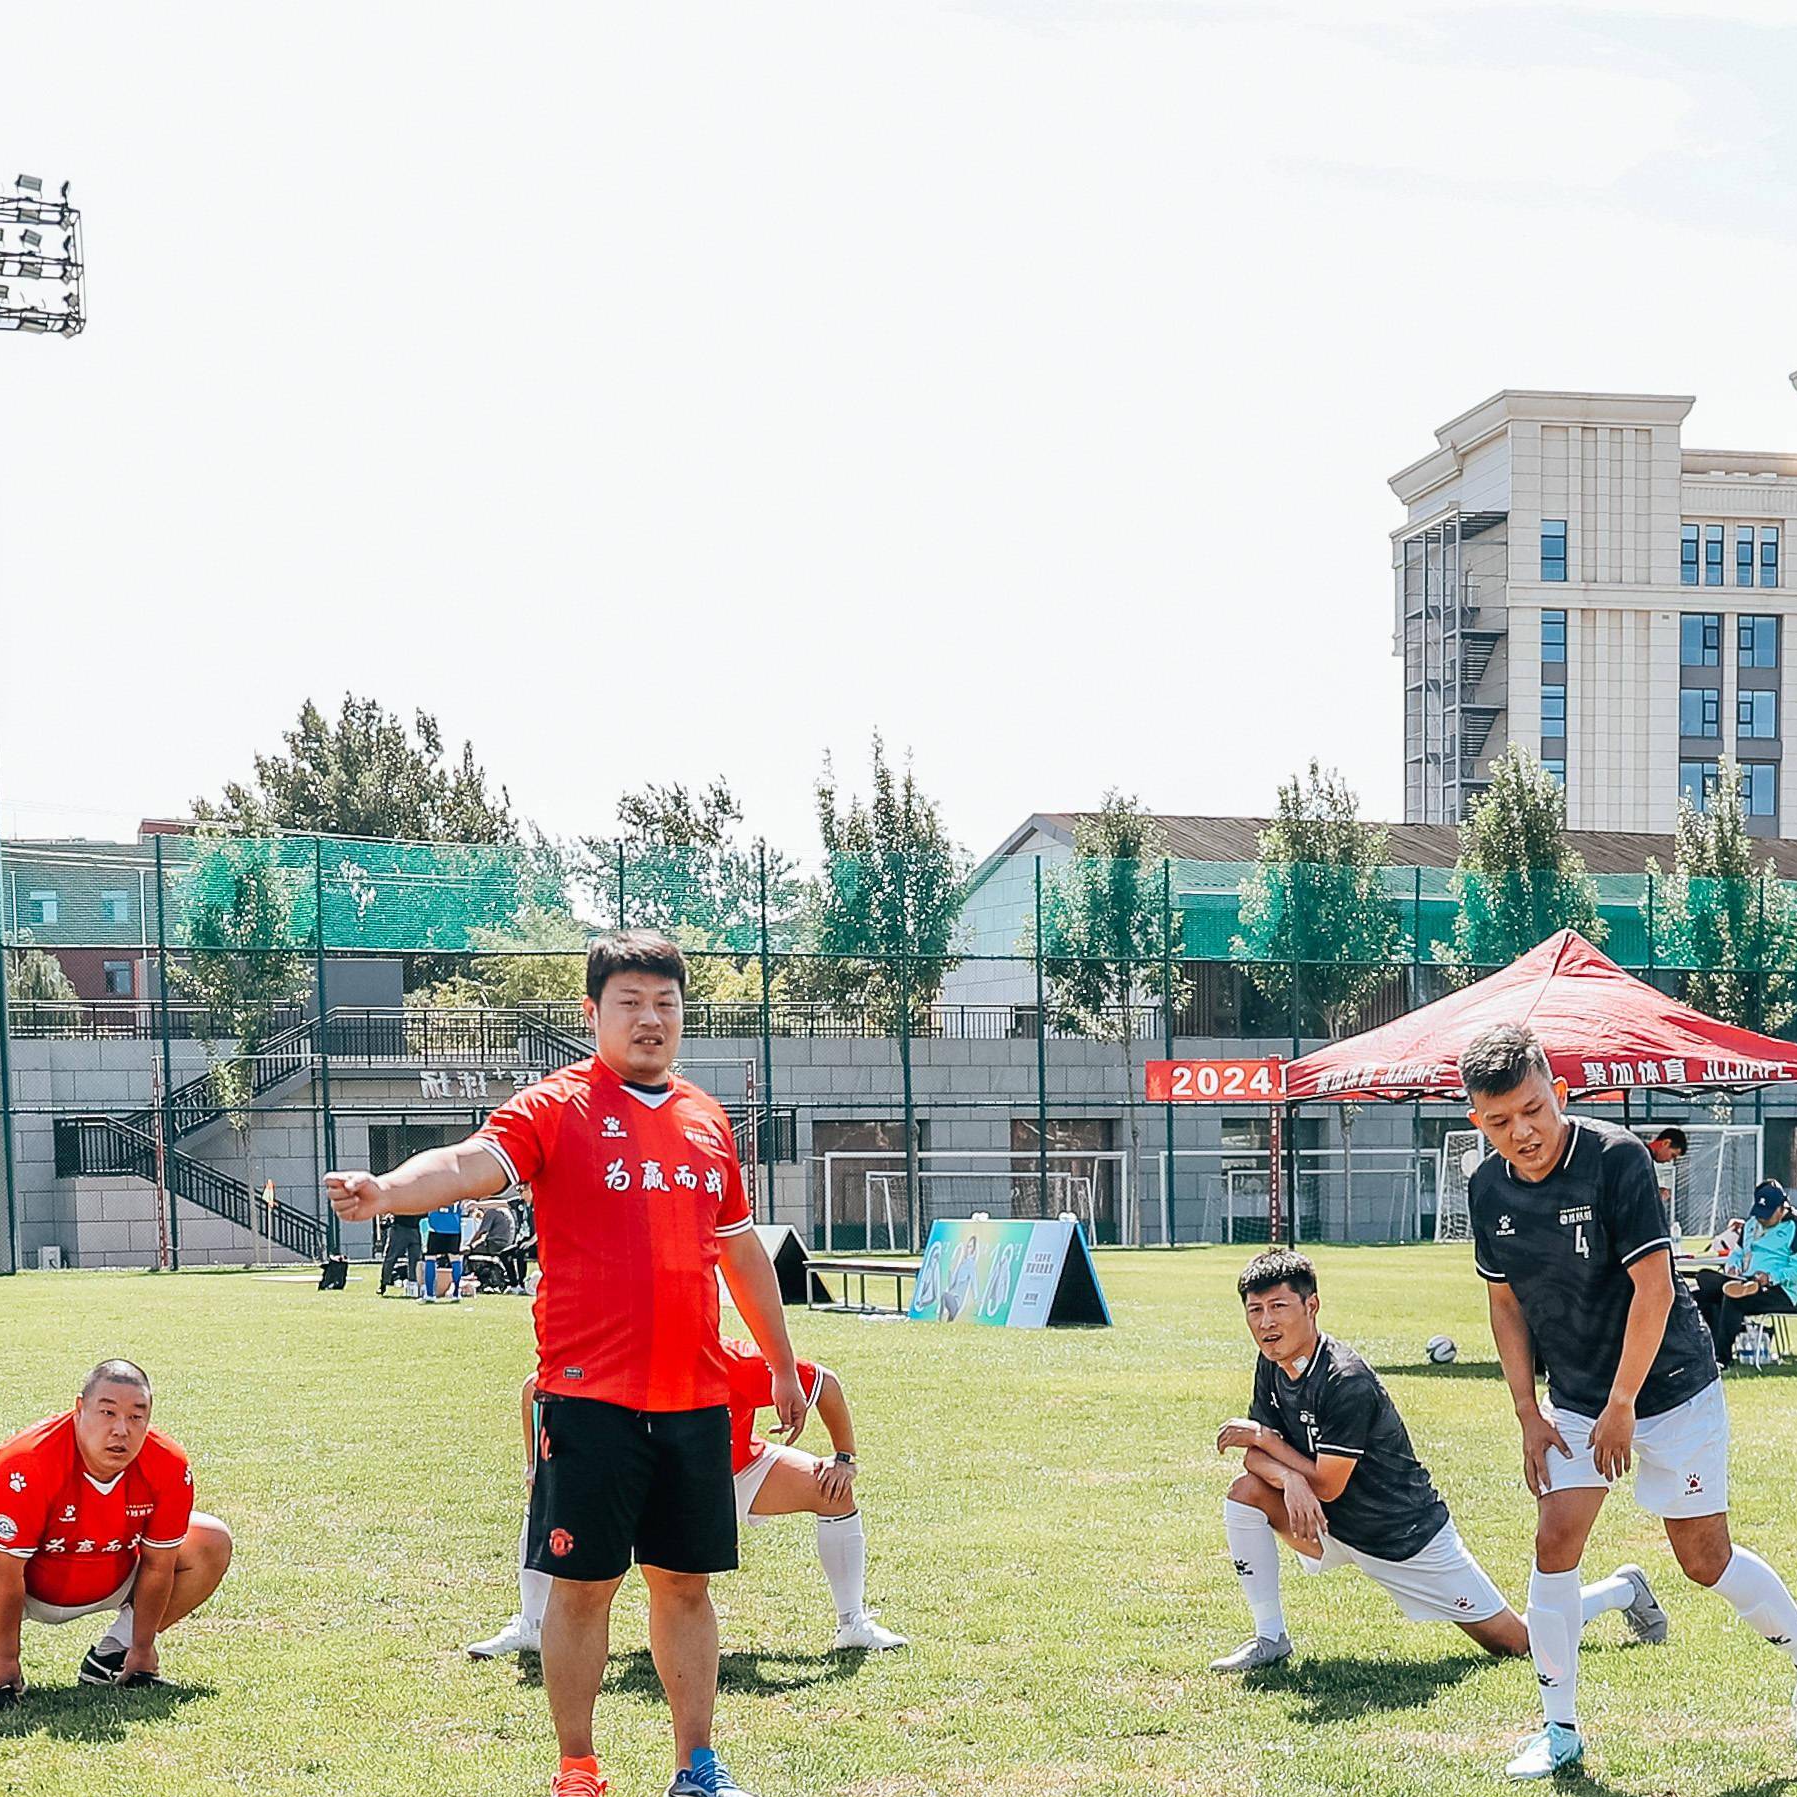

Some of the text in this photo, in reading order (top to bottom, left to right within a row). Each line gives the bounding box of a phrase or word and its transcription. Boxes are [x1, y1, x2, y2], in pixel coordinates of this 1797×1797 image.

[1171, 1064, 1286, 1096] 2024
[1581, 1058, 1687, 1086] 聚加体育
[604, 1158, 723, 1202] 为赢而战
[1575, 1225, 1590, 1259] 4
